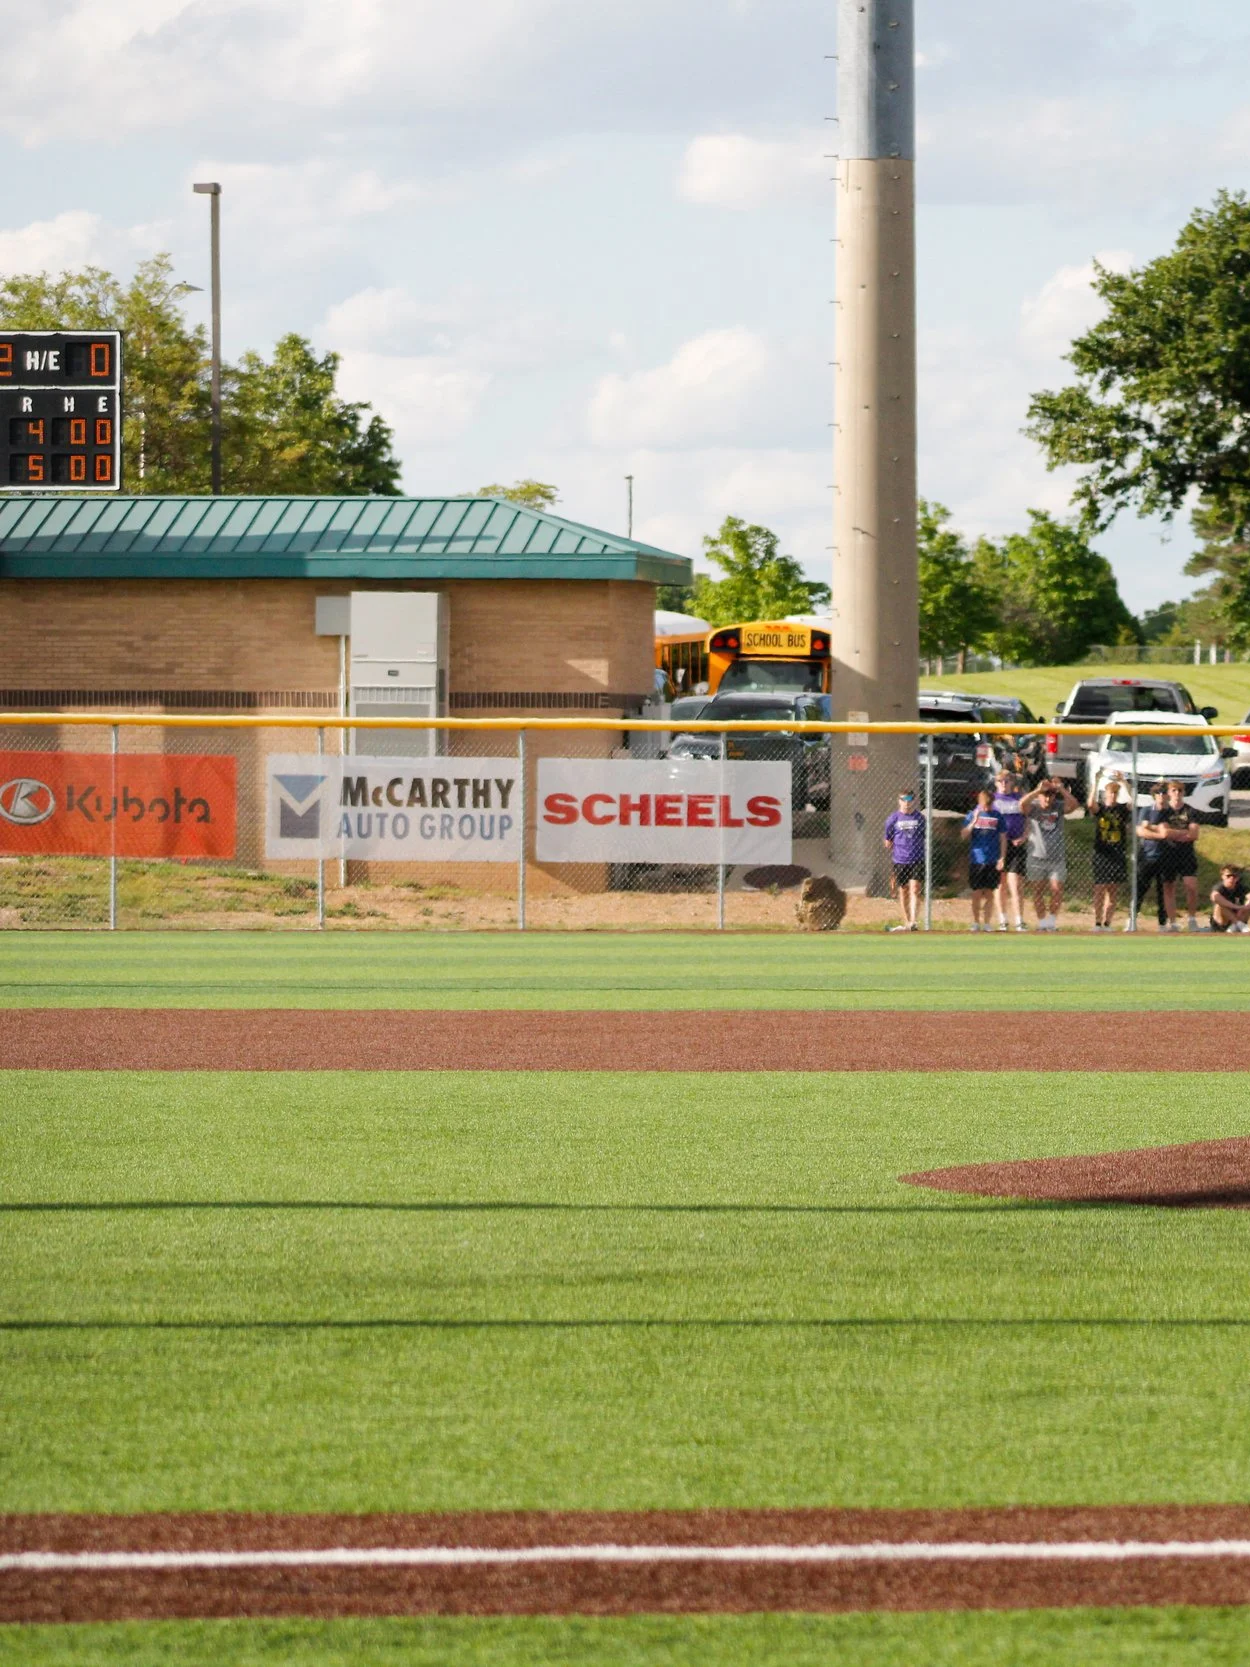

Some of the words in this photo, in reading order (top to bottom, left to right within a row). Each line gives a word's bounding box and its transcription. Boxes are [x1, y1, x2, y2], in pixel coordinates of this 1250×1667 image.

[26, 351, 60, 371] H/E
[91, 344, 109, 376] 0
[22, 397, 33, 412] R
[64, 397, 74, 412] H
[98, 397, 108, 412] E
[28, 419, 43, 444] 4
[71, 419, 86, 444] 0
[96, 419, 111, 444] 0
[28, 456, 43, 480] 5
[71, 456, 86, 480] 0
[96, 456, 111, 480] 0
[746, 633, 783, 648] SCHOOL
[787, 634, 806, 648] BUS
[66, 784, 212, 824] Kubota
[341, 776, 515, 809] McCARTHY
[543, 793, 782, 828] SCHEELS
[337, 812, 410, 840] AUTO
[419, 814, 513, 841] GROUP
